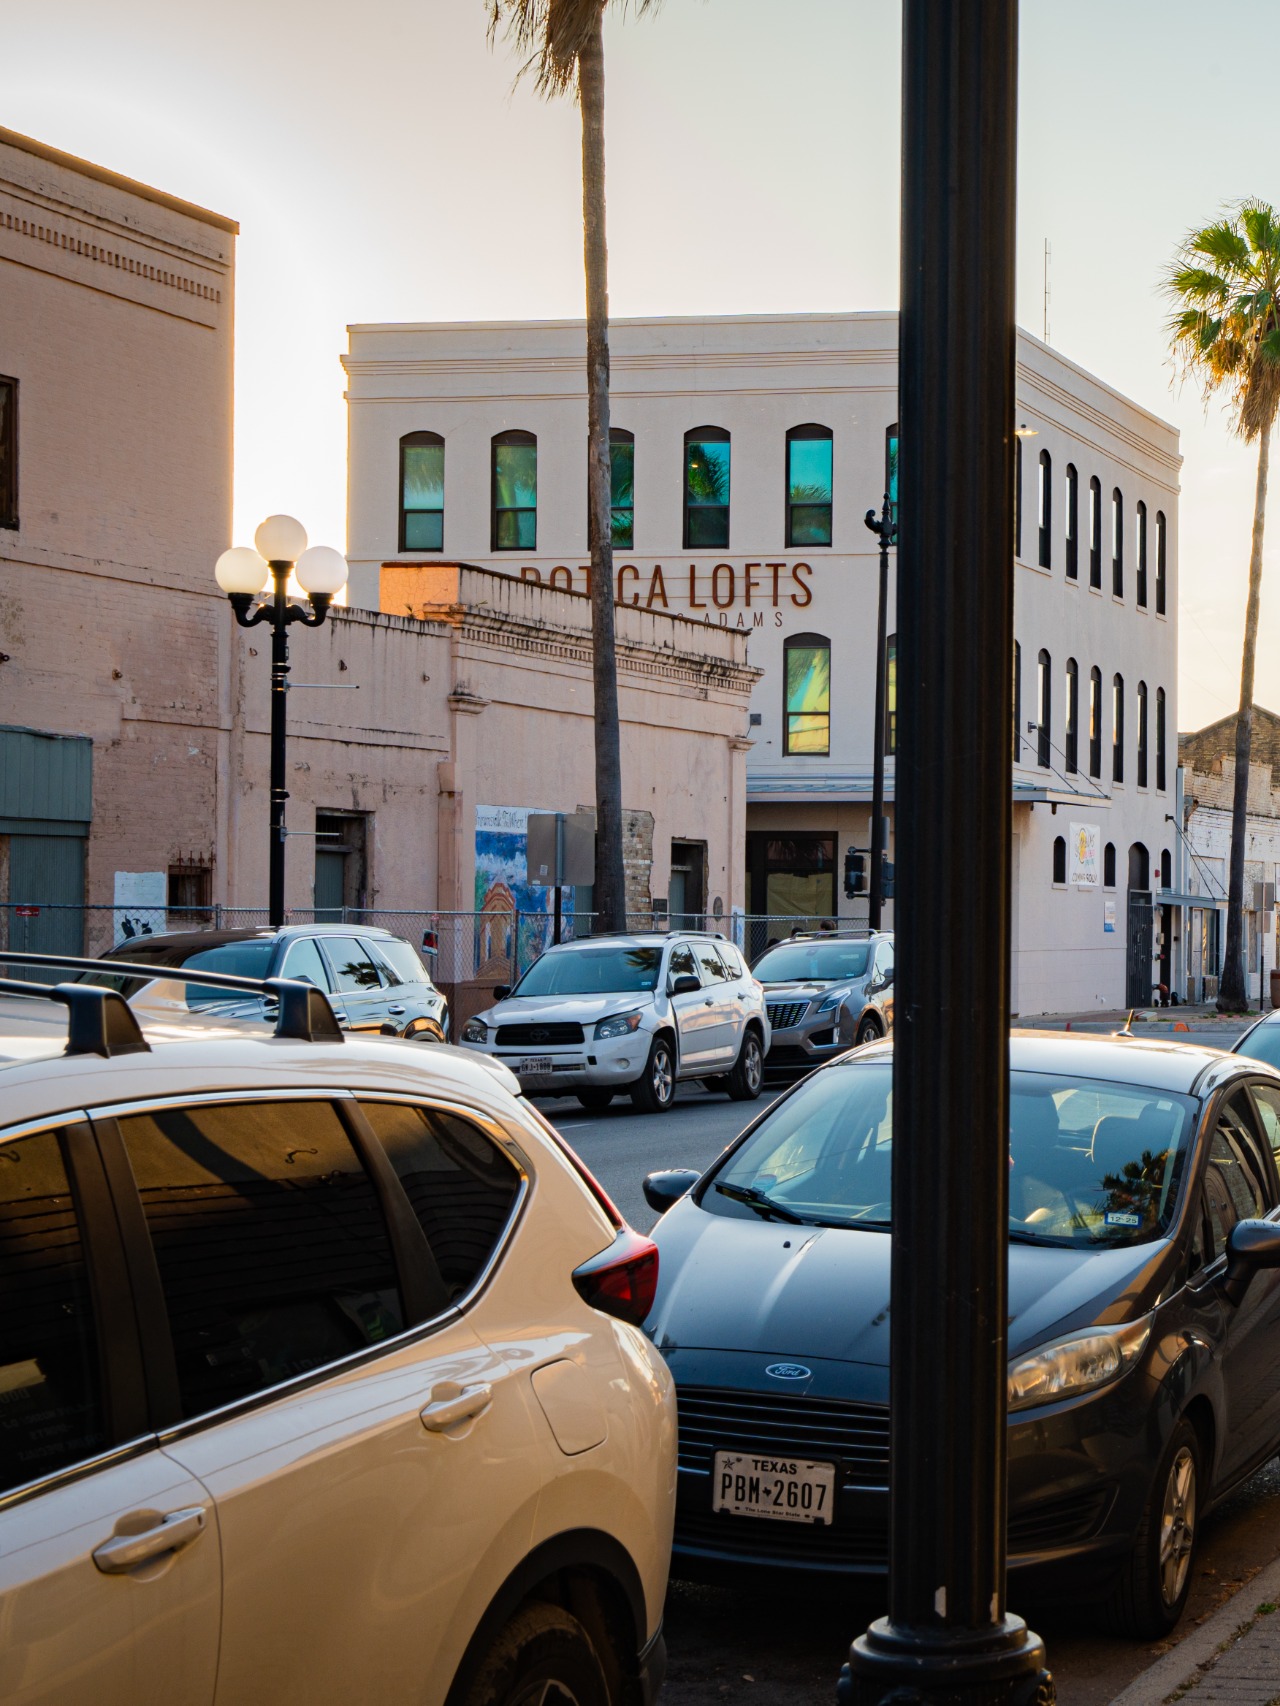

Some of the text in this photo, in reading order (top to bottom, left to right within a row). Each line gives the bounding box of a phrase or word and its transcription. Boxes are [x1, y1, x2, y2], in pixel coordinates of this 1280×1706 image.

[689, 562, 813, 608] LOFTS
[704, 611, 783, 628] ADAMS
[752, 1459, 798, 1475] TEXAS
